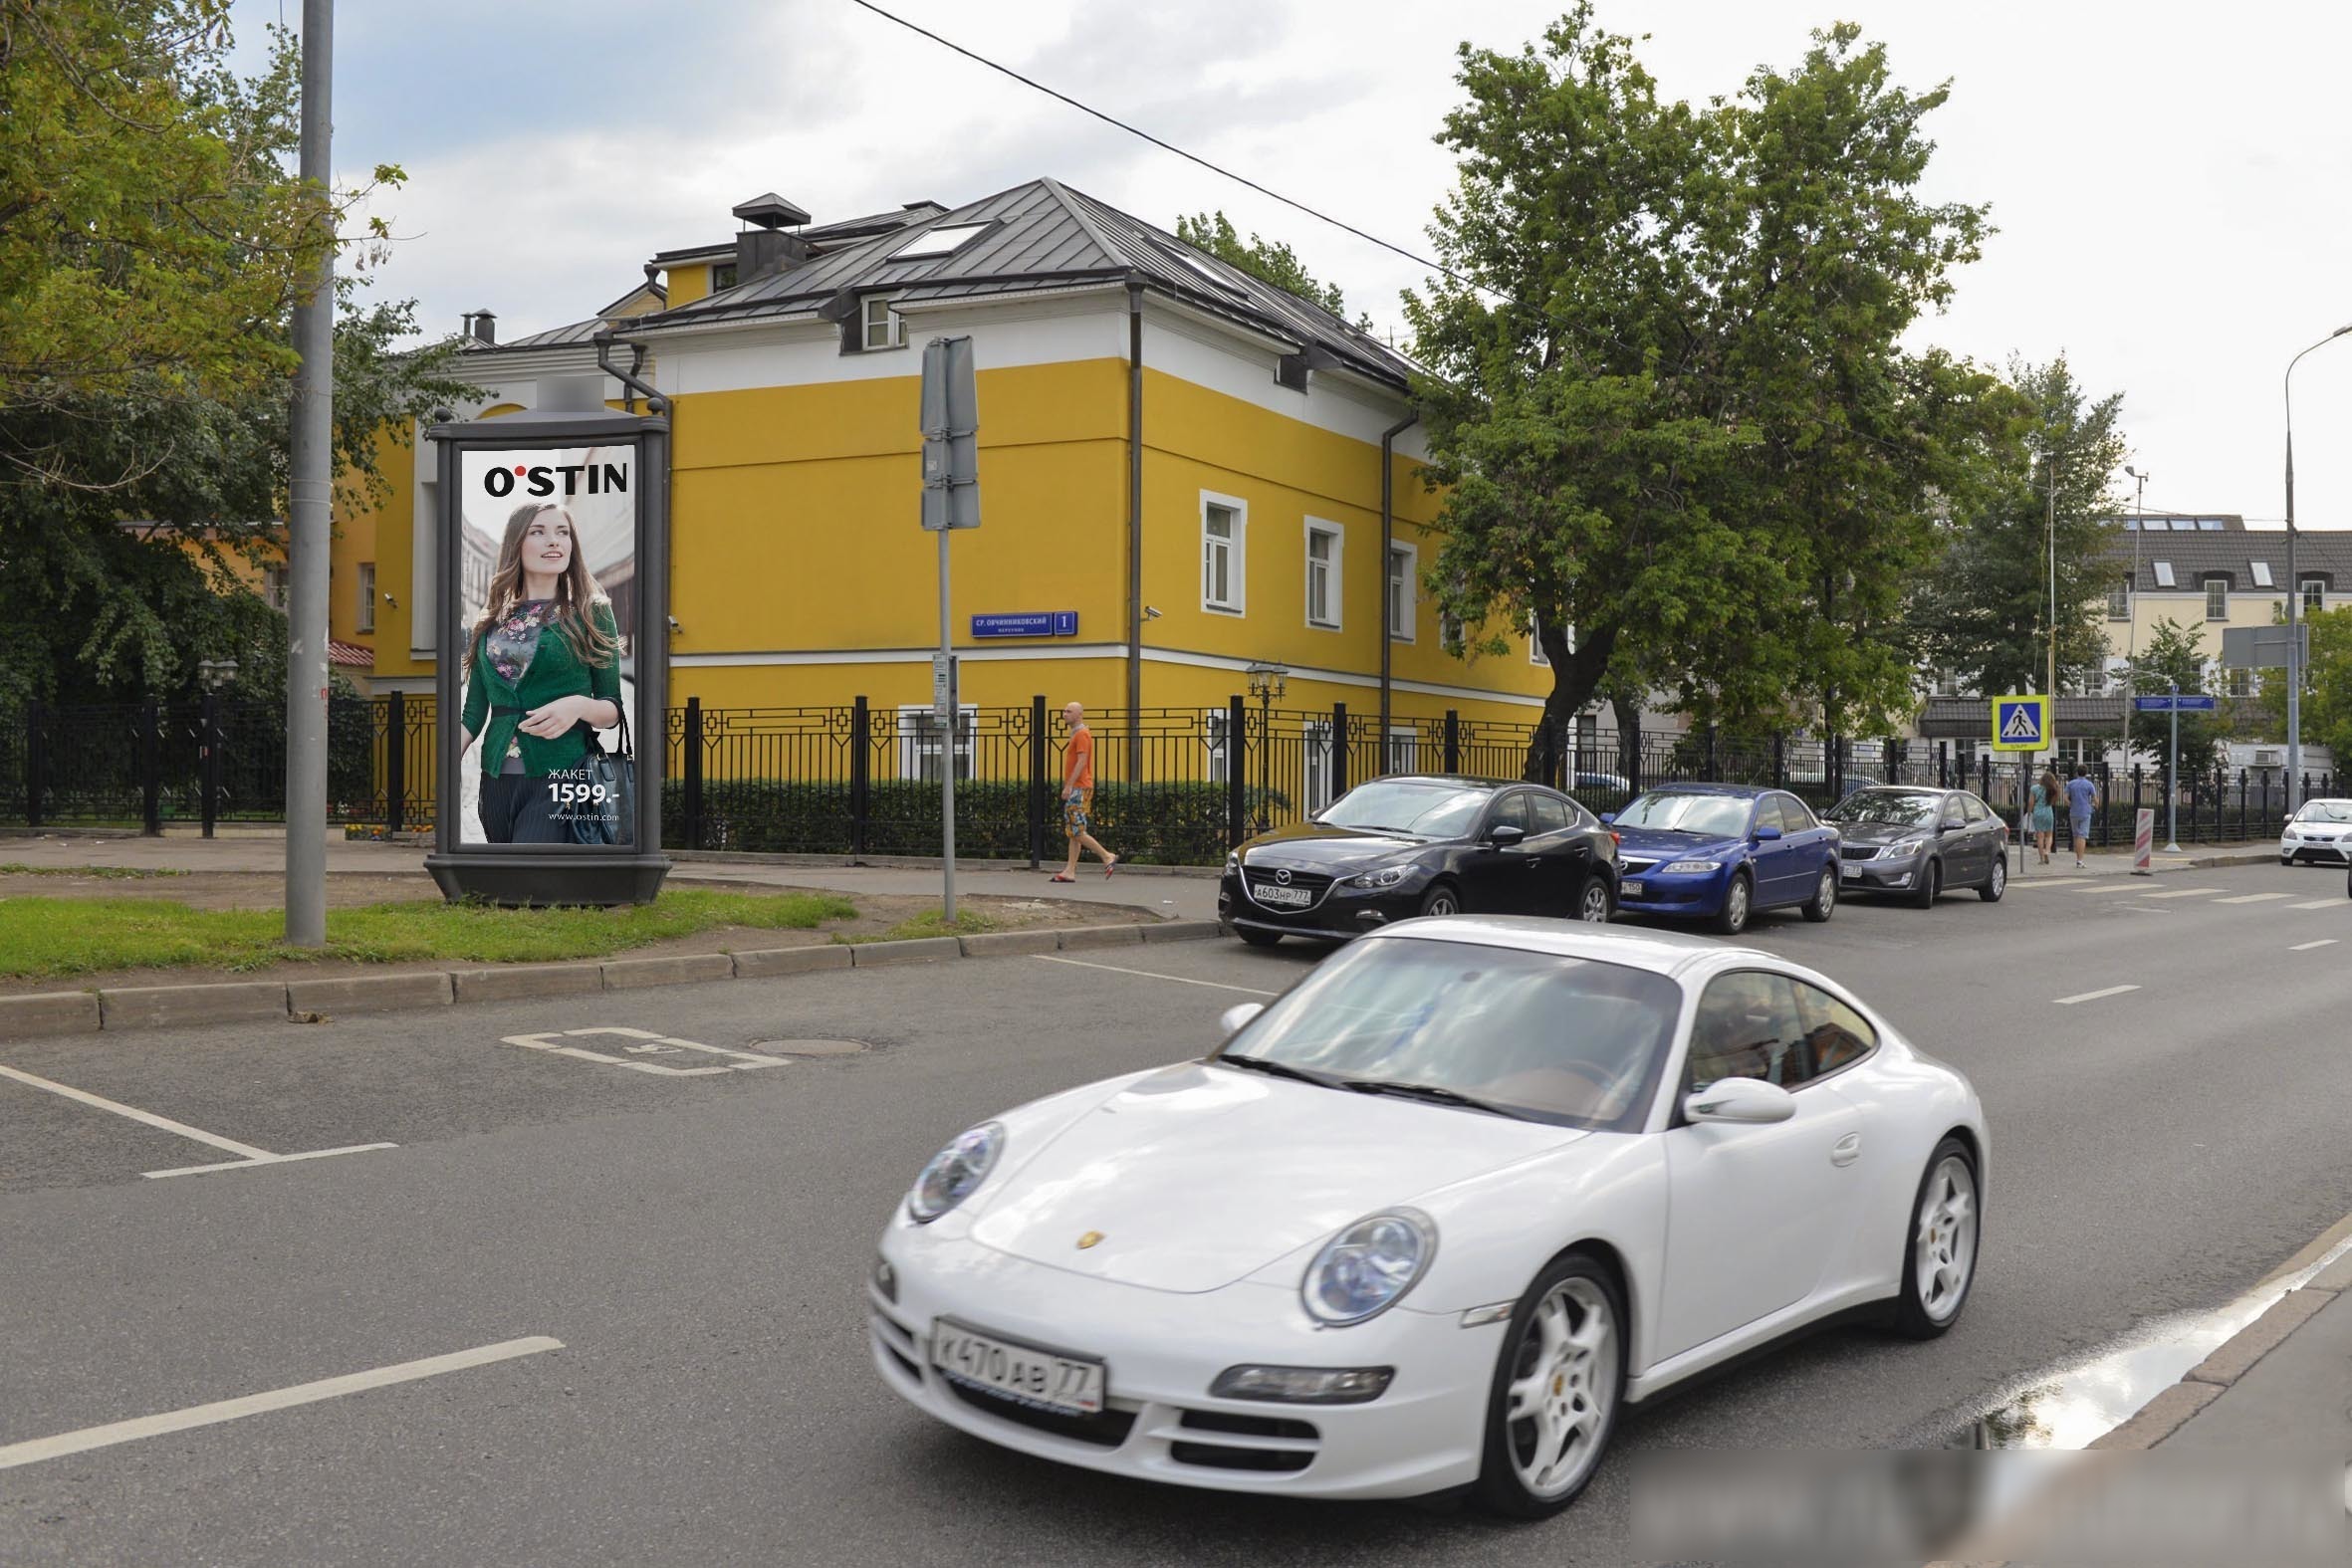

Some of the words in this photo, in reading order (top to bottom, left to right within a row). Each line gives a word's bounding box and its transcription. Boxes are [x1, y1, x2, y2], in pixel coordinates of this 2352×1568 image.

[1061, 615, 1067, 628] 1
[548, 769, 593, 781] ЖАКЕТ
[548, 812, 620, 821] www.ostin.com
